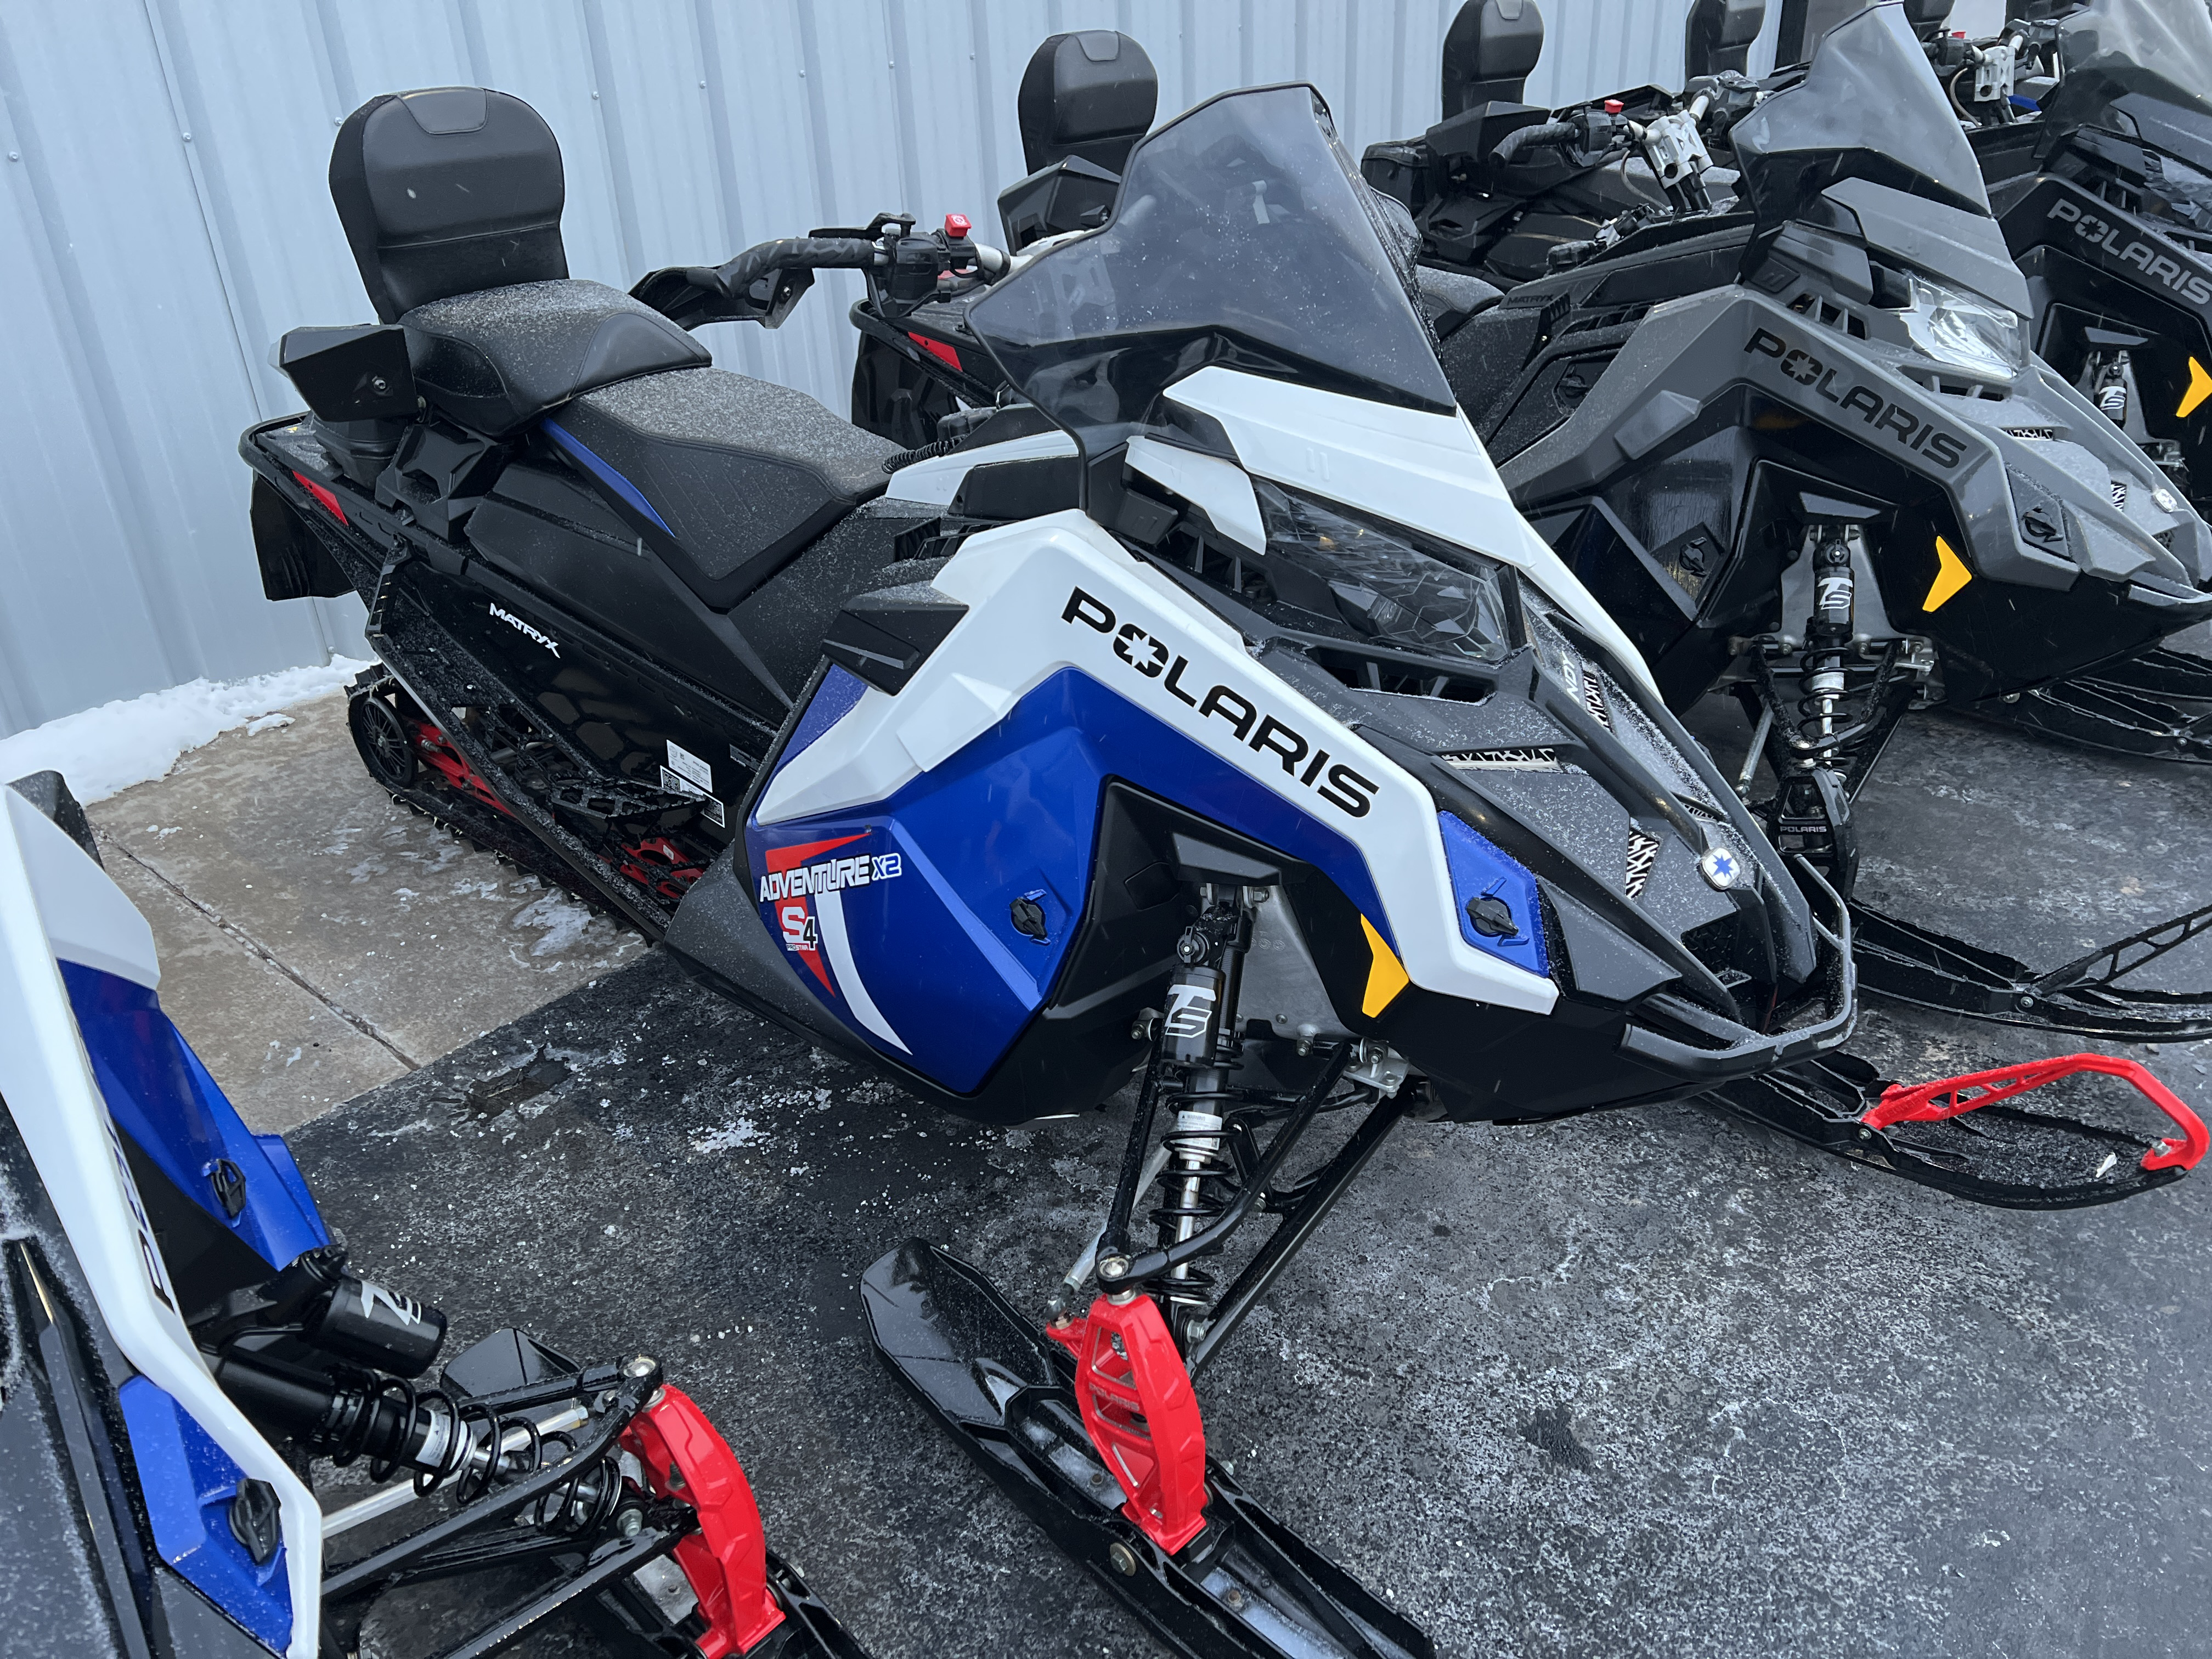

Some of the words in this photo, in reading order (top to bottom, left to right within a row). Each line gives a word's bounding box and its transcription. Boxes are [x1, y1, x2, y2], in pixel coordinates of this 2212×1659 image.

[2047, 198, 2212, 305] POLARIS
[1743, 327, 1968, 469] POLARIS
[489, 602, 559, 659] MATRYX
[1061, 586, 1380, 818] POLARIS
[759, 855, 871, 903] ADVENTURE
[871, 853, 902, 881] X2
